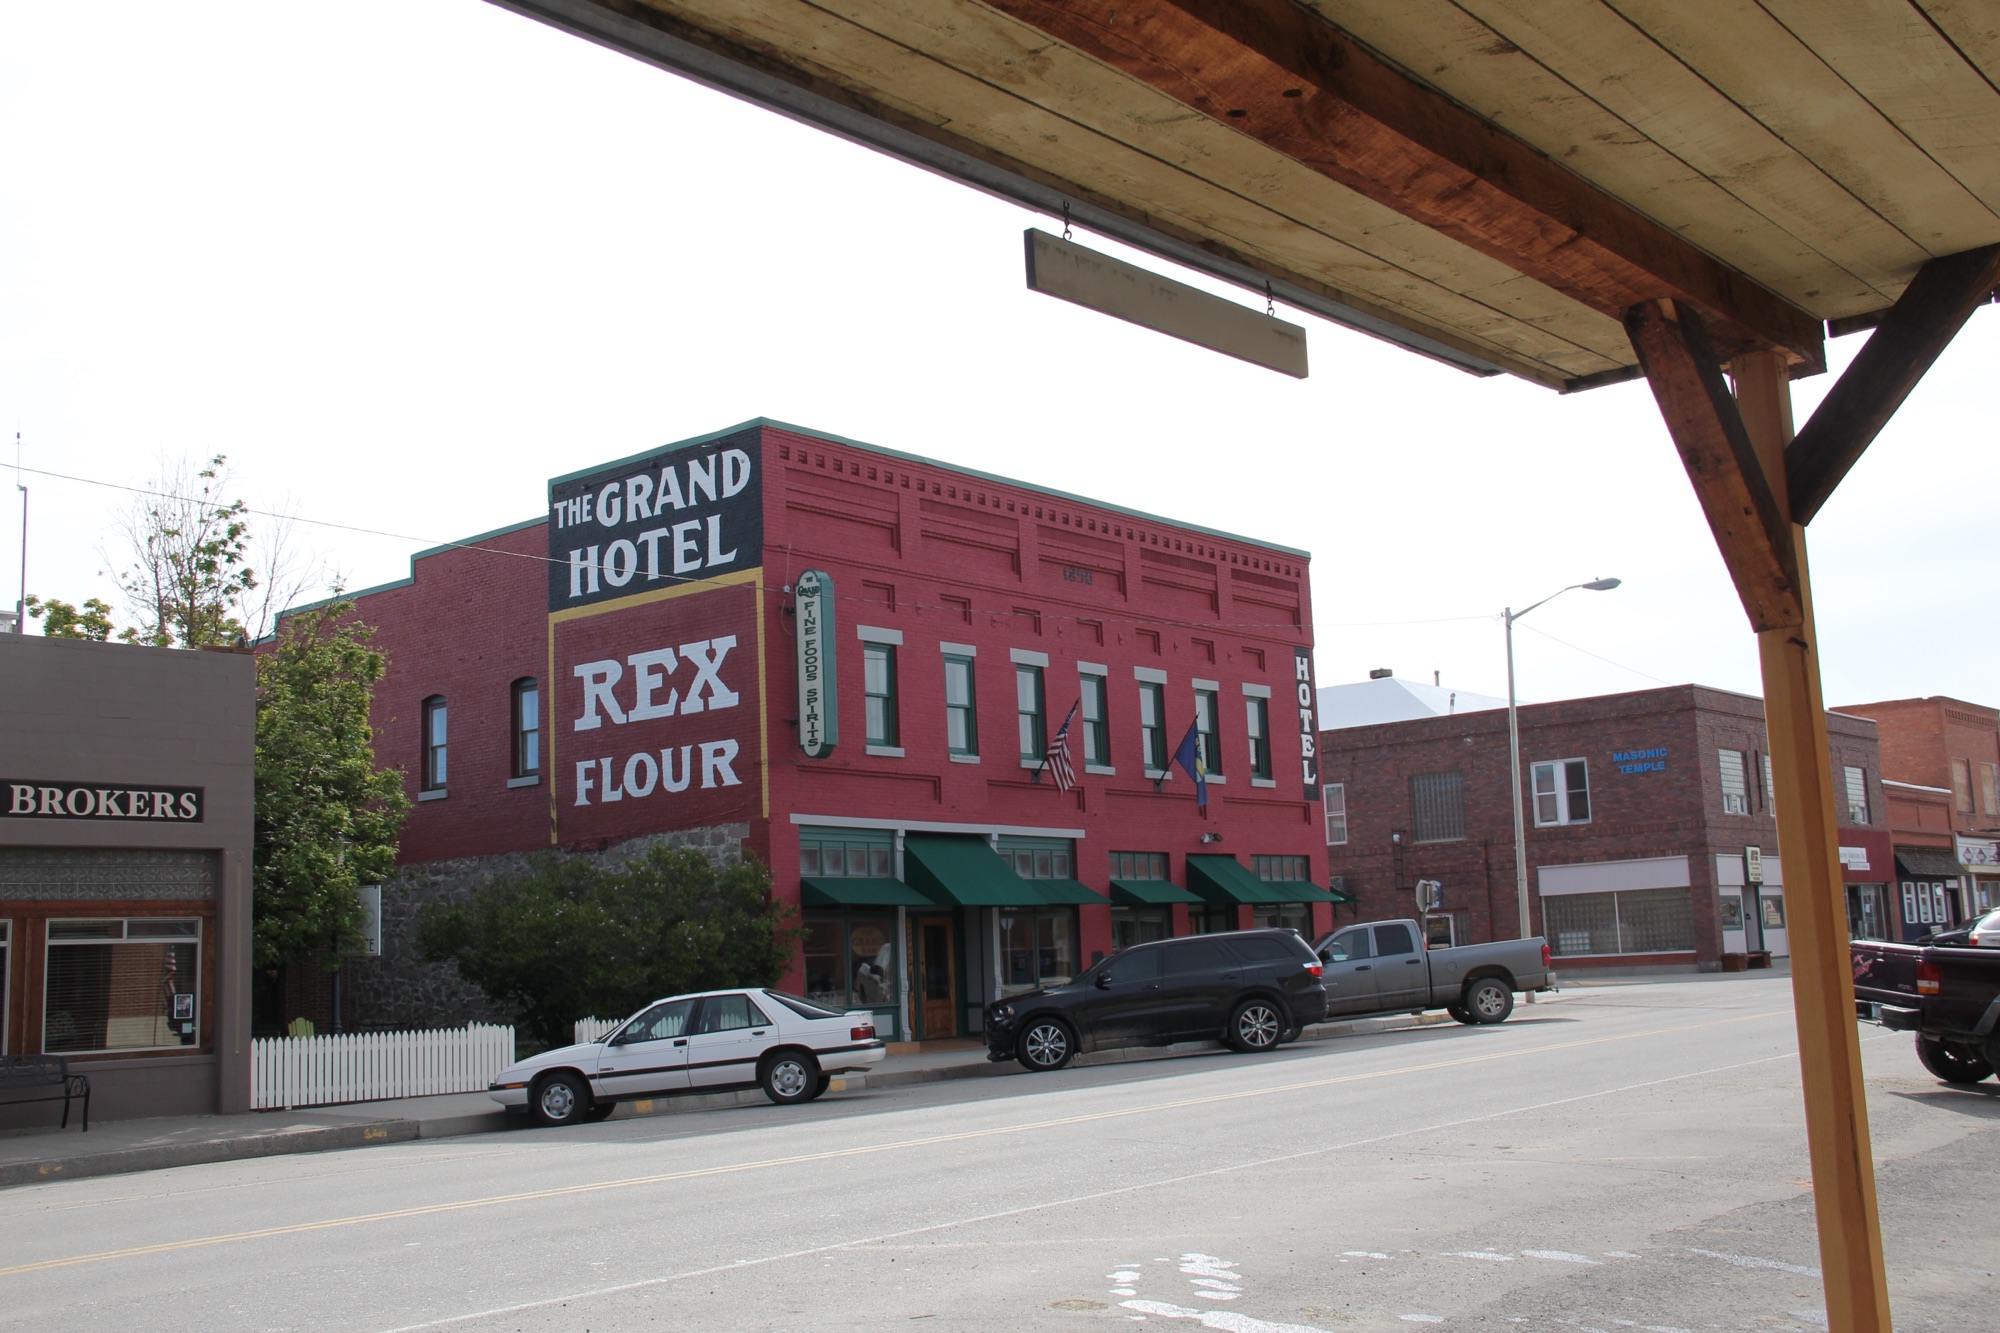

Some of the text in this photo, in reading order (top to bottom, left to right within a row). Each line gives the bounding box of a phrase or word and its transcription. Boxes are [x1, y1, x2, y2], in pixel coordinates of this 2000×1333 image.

[554, 449, 751, 529] THE GRAND
[569, 514, 738, 598] HOTEL
[574, 634, 739, 731] REX
[803, 601, 819, 747] FINE FOODS SPIRITS
[1295, 656, 1316, 785] HOTEL
[1612, 747, 1668, 762] MASONIC
[8, 784, 197, 819] BROKERS
[574, 738, 743, 807] FLOUR
[1618, 760, 1665, 774] TEMPLE
